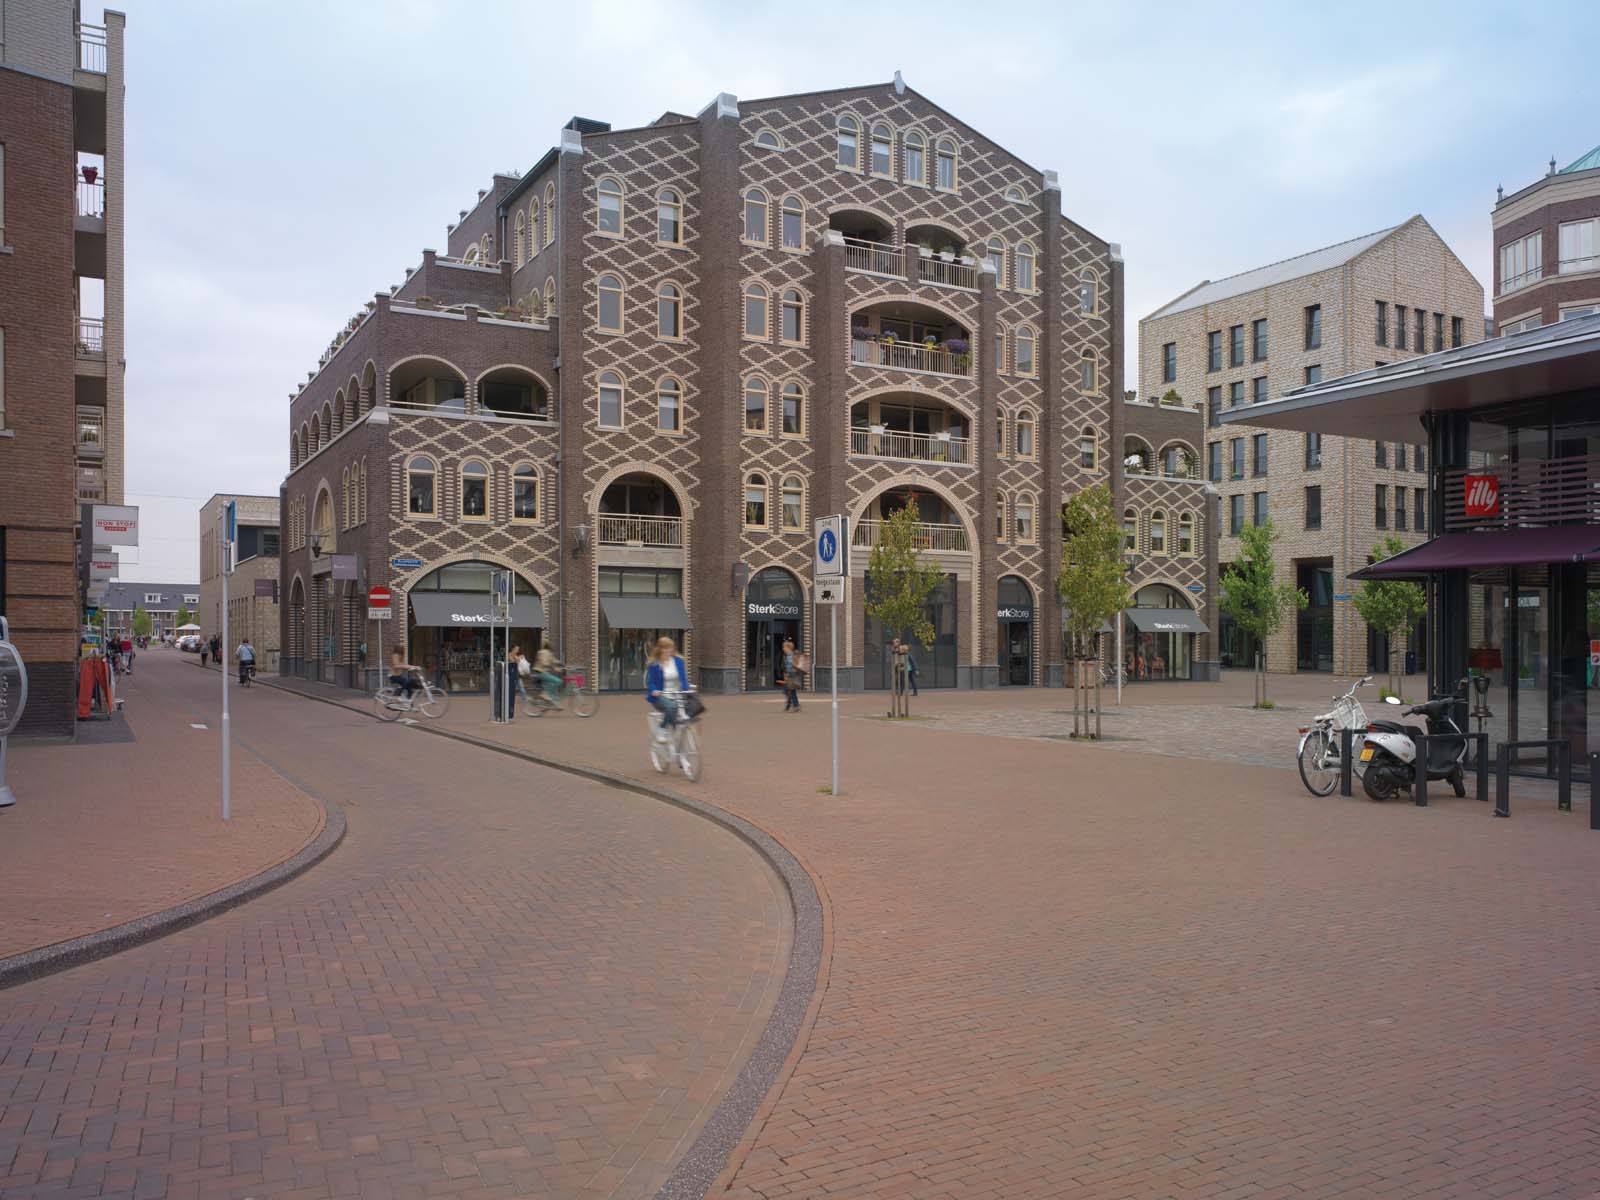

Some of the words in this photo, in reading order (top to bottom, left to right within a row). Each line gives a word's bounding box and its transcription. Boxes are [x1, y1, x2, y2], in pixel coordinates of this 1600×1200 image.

[1468, 480, 1497, 511] illy
[748, 603, 799, 615] SterkStore
[997, 608, 1030, 618] erkStore
[451, 613, 513, 623] SterkSoe
